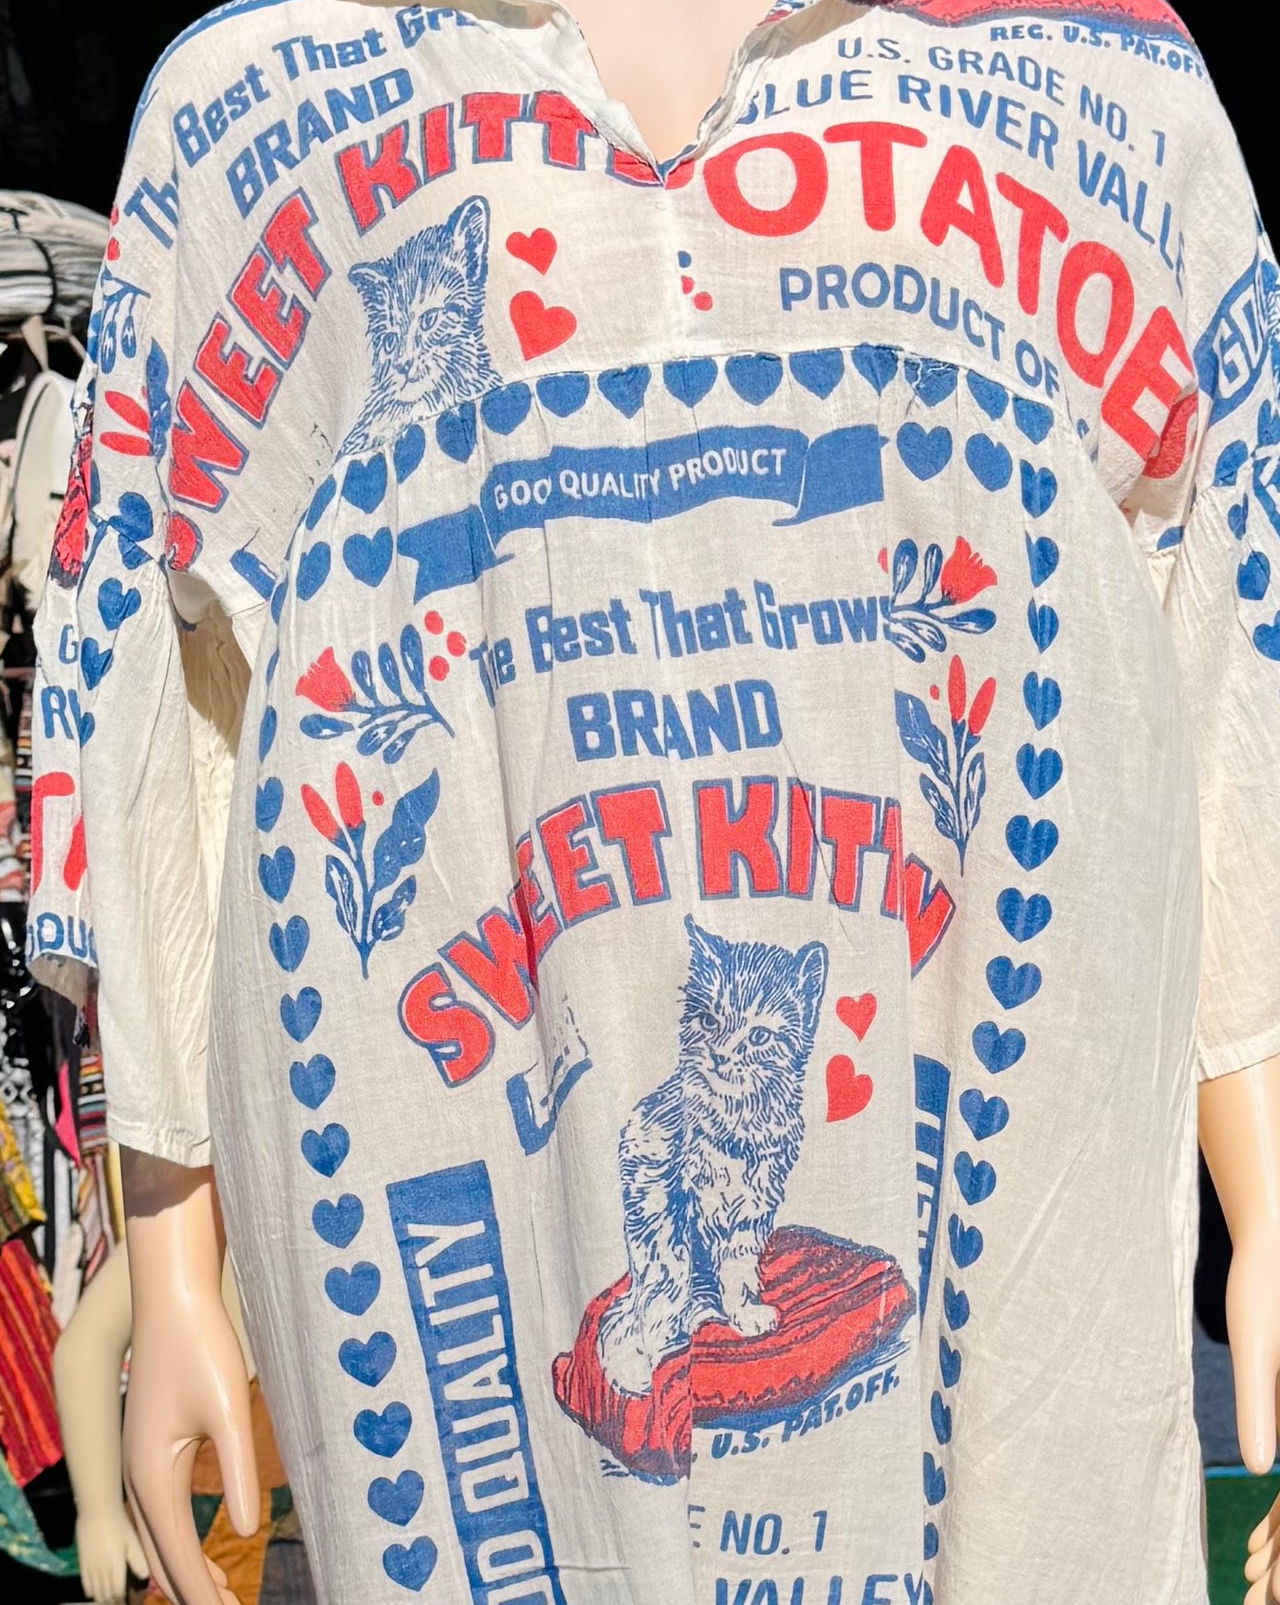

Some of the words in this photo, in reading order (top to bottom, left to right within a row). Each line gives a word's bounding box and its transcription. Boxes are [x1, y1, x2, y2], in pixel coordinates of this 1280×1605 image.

[990, 23, 1053, 42] REG.
[1063, 24, 1111, 49] U.S.
[173, 64, 271, 168] Best
[273, 27, 387, 81] That
[225, 67, 414, 220] BRAND
[838, 36, 911, 66] U.S.
[928, 46, 1065, 107] GRADE
[1080, 84, 1135, 152] NO.
[1152, 129, 1166, 167] 1
[898, 75, 1058, 171] RIVER
[779, 262, 1007, 363] PRODUCT
[1014, 340, 1060, 395] OF
[558, 468, 661, 500] QUALITY
[668, 448, 788, 492] PRODUCT
[524, 598, 638, 674] Best
[639, 588, 754, 659] That
[566, 678, 783, 763] BRAND
[406, 1219, 530, 1513] QUALITY
[711, 1429, 769, 1461] U.S.
[781, 1366, 900, 1444] PAT.OFF.
[720, 1511, 791, 1556] NO.
[814, 1510, 829, 1553] 1
